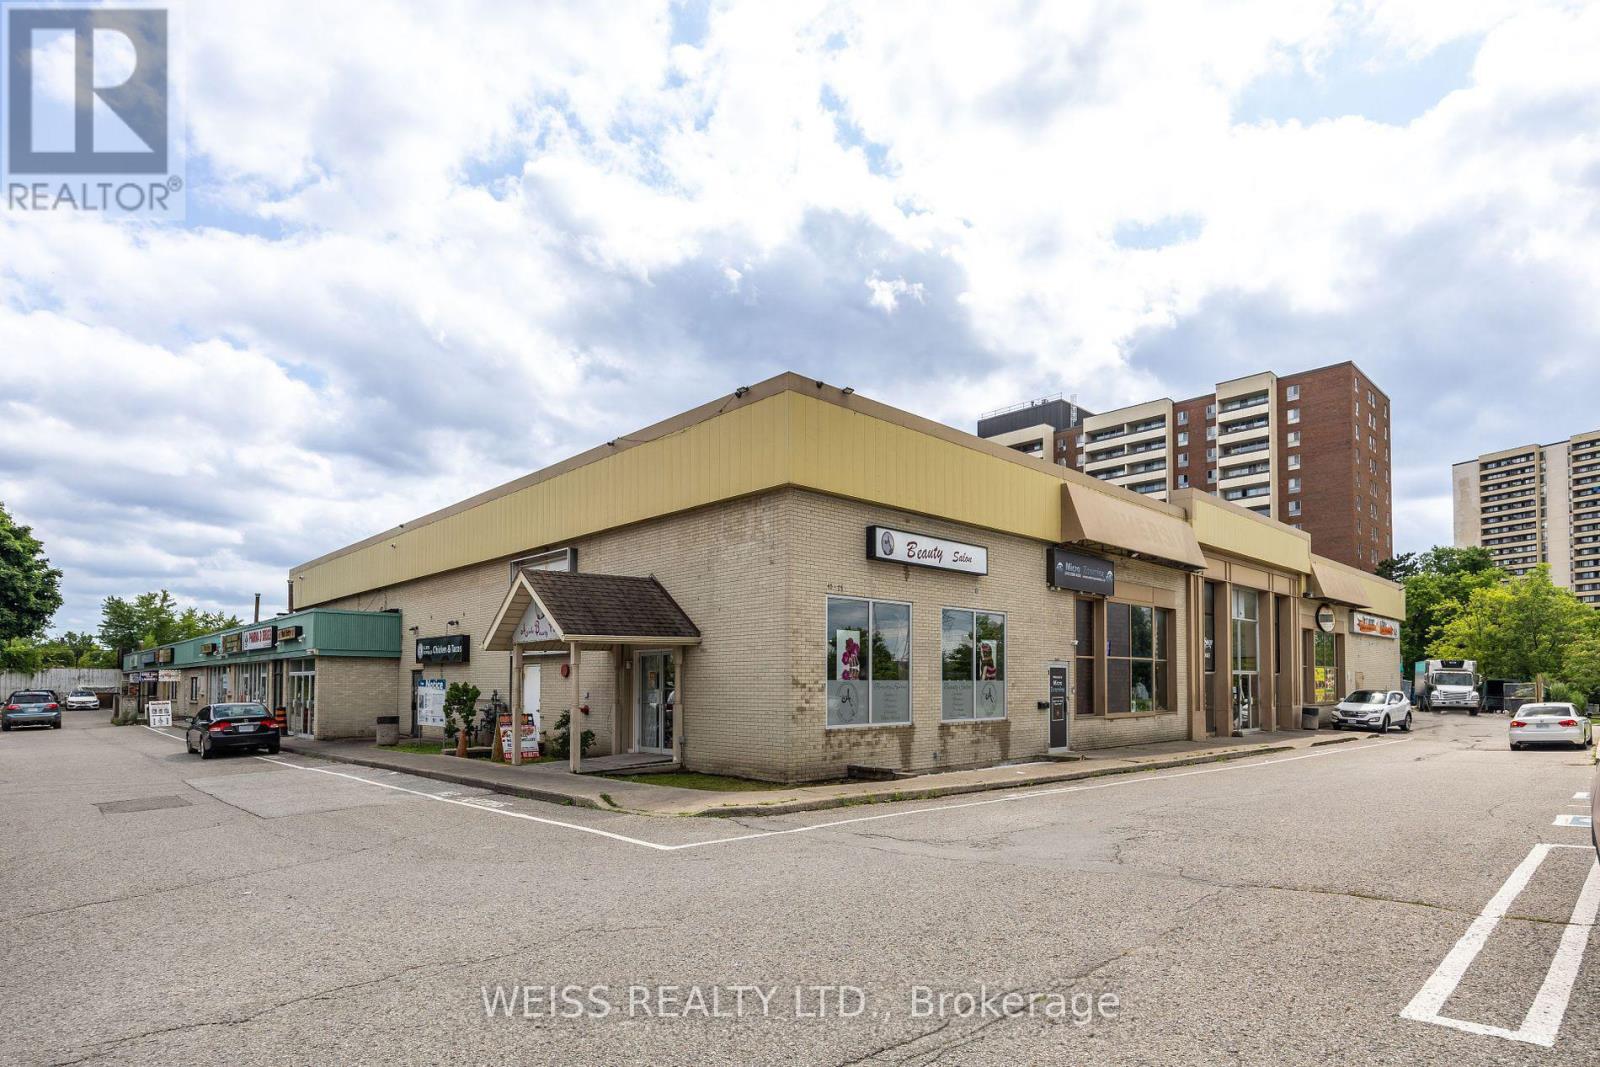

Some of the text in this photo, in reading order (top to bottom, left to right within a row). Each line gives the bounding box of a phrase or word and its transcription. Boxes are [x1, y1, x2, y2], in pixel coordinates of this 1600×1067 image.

[906, 541, 973, 563] Beauty Salon
[1065, 562, 1080, 572] Micro
[432, 645, 447, 655] Chicken
[451, 644, 463, 653] Tacos
